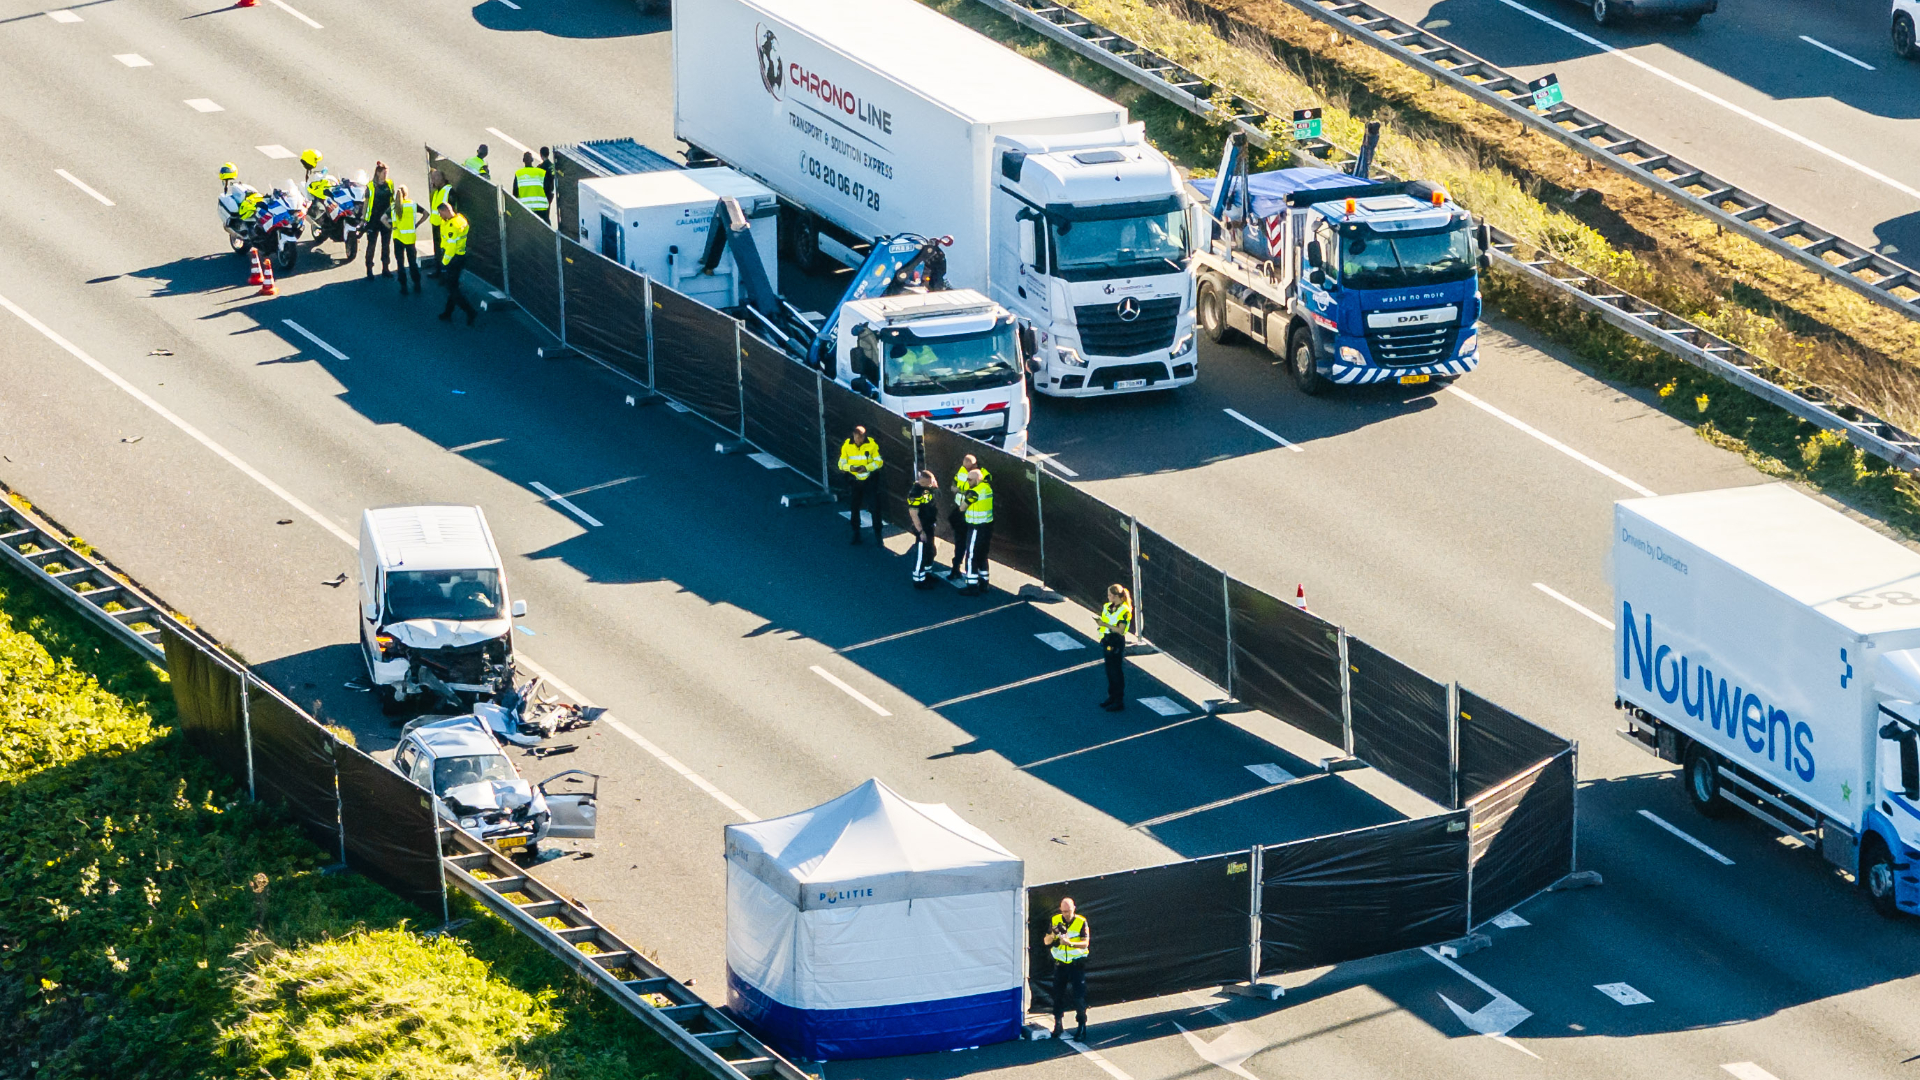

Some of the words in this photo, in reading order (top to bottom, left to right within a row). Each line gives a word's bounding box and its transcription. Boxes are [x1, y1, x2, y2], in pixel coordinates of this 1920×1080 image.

[789, 112, 822, 142] TRANSPORT
[831, 136, 861, 163] SOLUTION
[864, 152, 893, 180] EXPRESS
[809, 156, 821, 180] 03
[823, 165, 836, 188] 20
[837, 173, 850, 196] 06
[852, 181, 865, 203] 47
[867, 188, 880, 212] 28
[676, 216, 711, 226] CALAMITE
[1398, 314, 1429, 323] DAF
[941, 398, 975, 407] POLITIE
[1622, 528, 1646, 552] Driven
[1647, 541, 1655, 560] by
[1623, 600, 1816, 783] Nouwens
[819, 888, 873, 904] POLITIE
